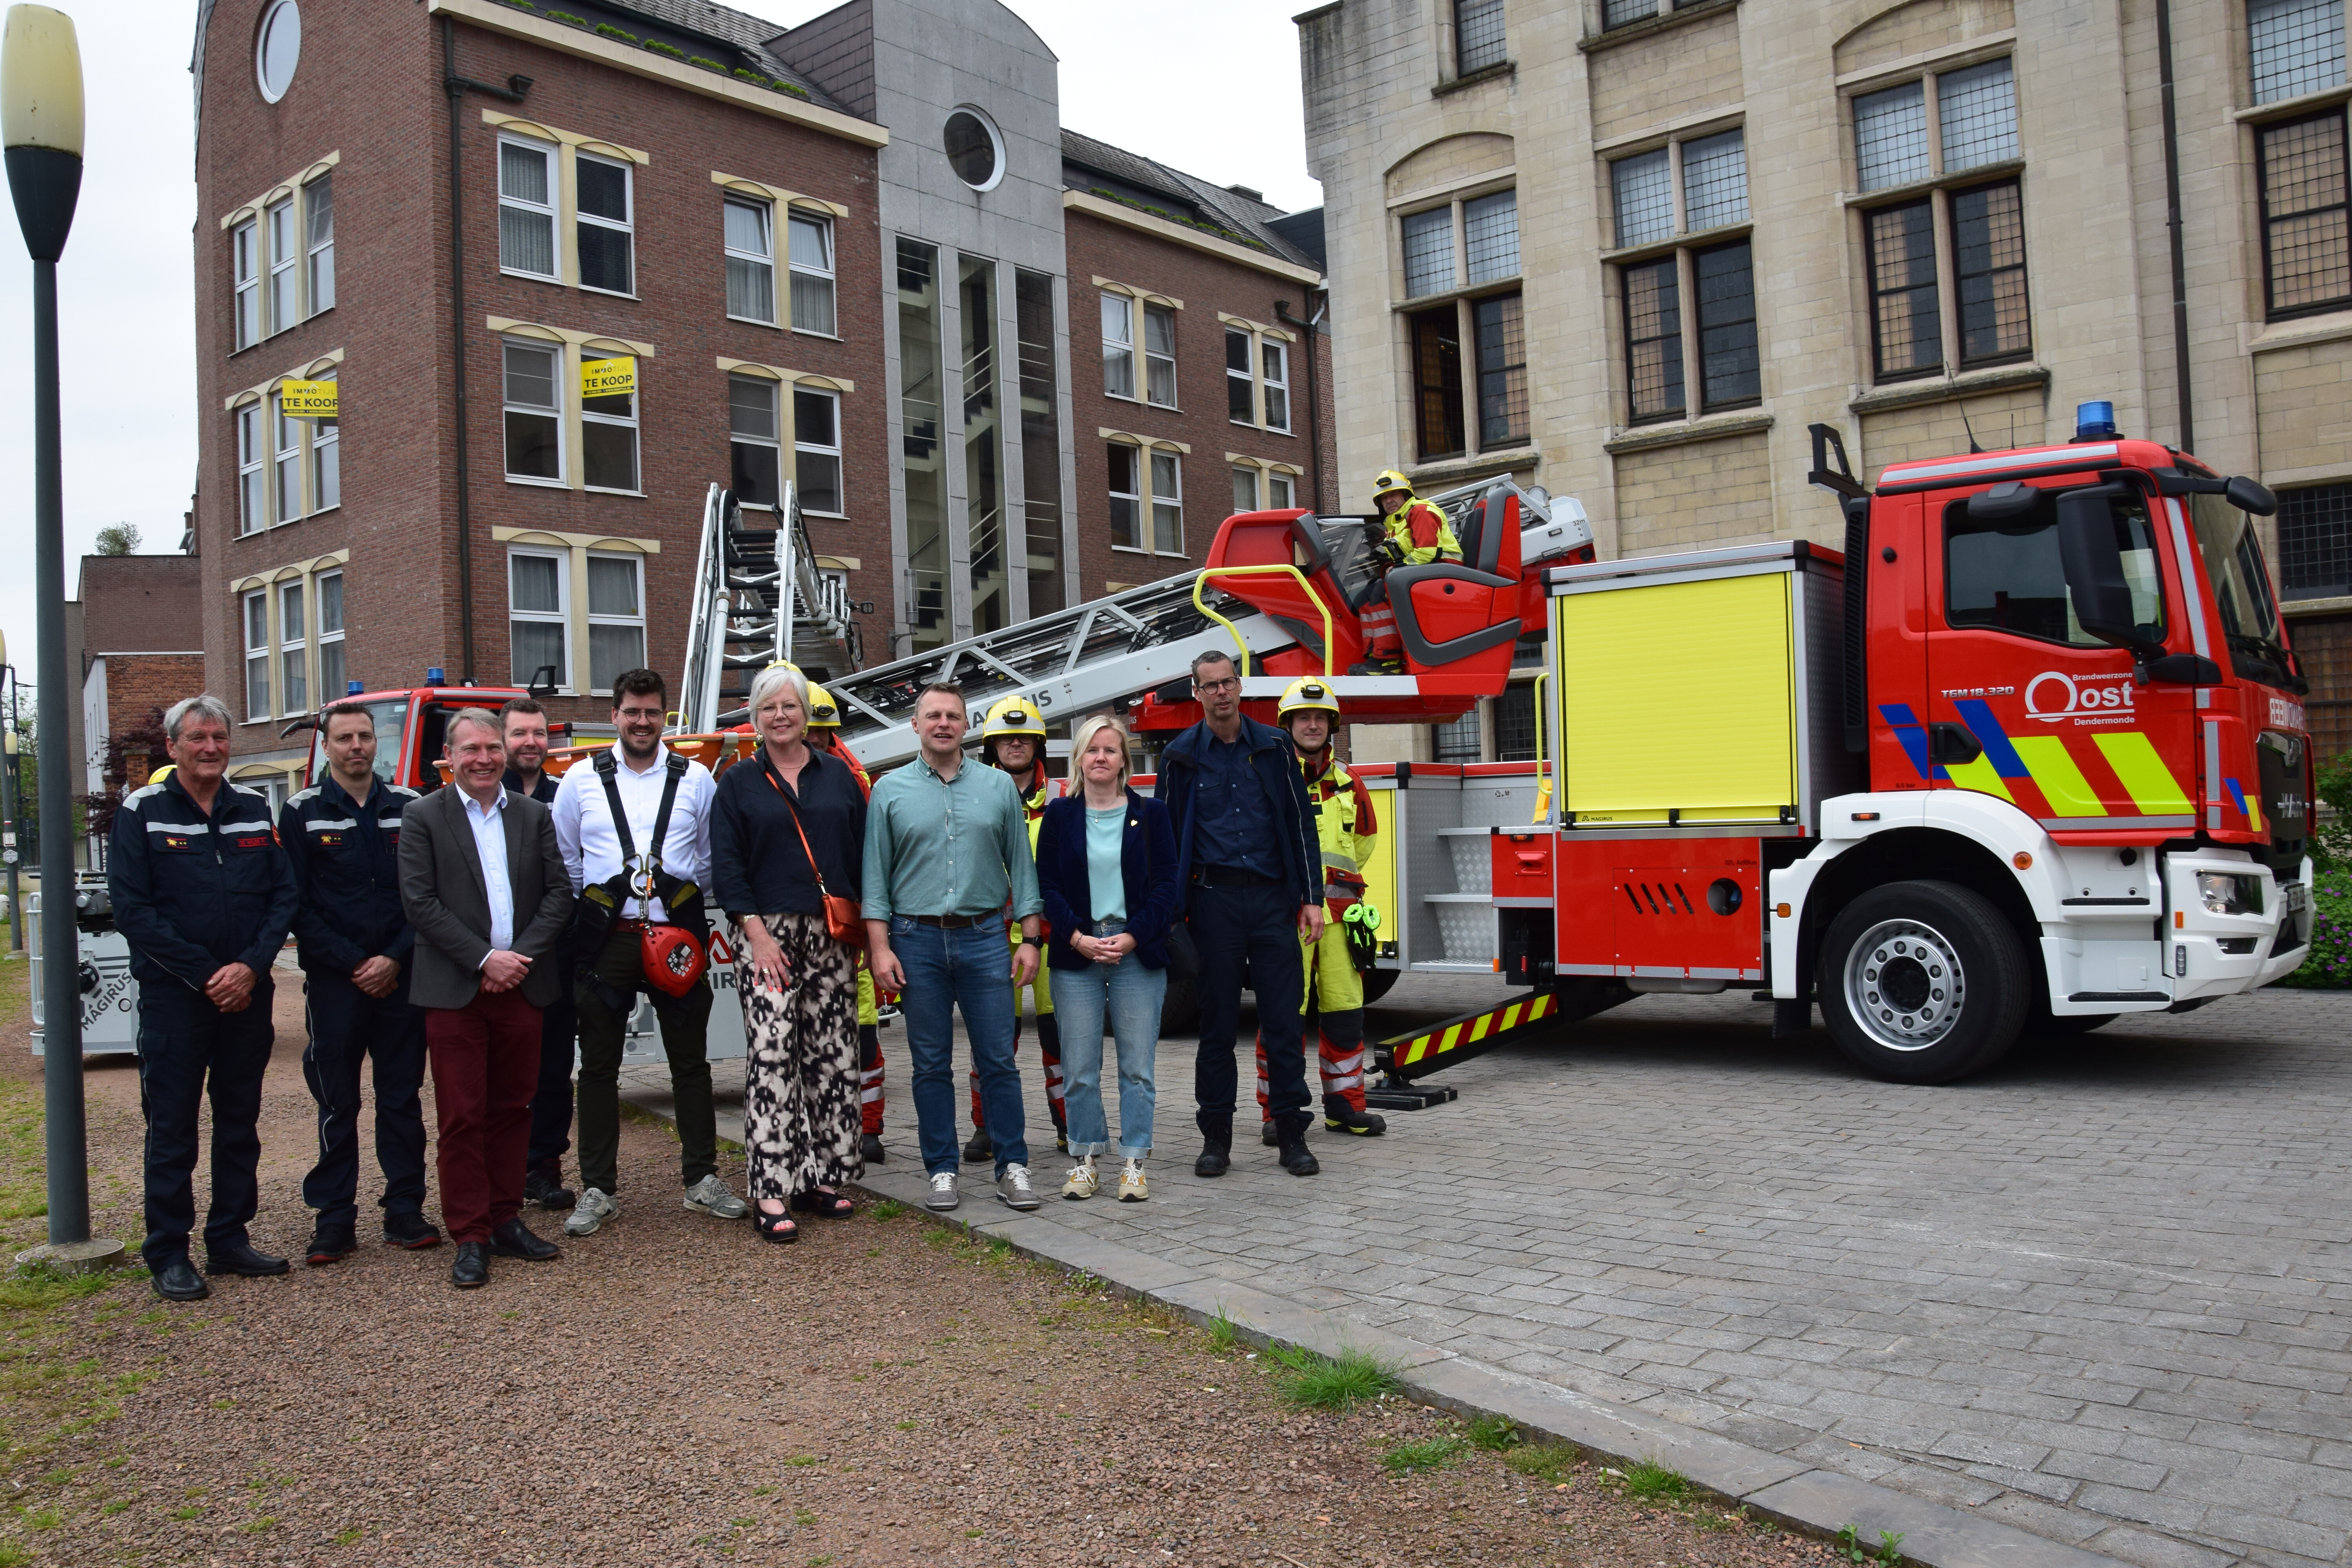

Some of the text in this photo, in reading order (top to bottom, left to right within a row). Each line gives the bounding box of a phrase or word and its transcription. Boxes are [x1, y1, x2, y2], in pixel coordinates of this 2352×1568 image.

[584, 375, 632, 388] TE KOOP
[285, 398, 300, 407] TE
[2073, 671, 2133, 681] Brandweerzone
[1941, 686, 2014, 698] TGM 18.320
[2074, 716, 2135, 725] Dendermonde
[81, 972, 132, 1031] MAGIRUS
